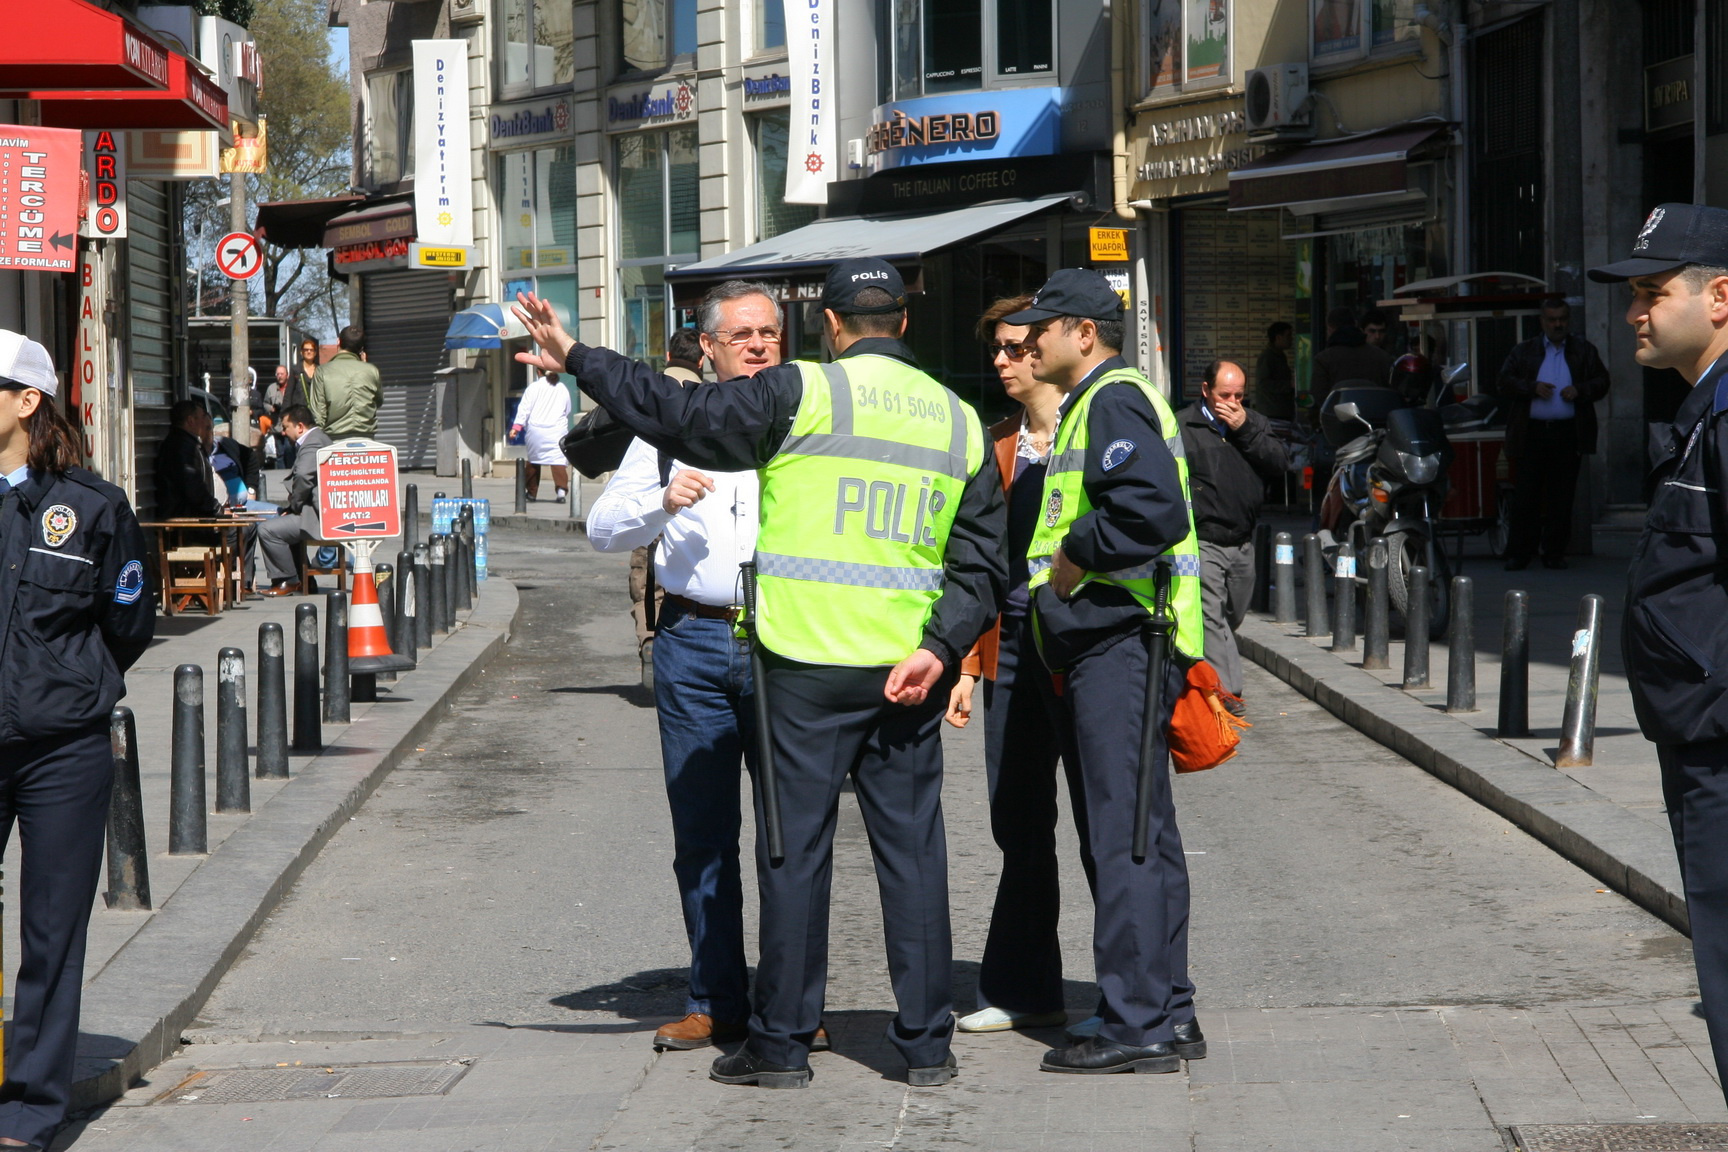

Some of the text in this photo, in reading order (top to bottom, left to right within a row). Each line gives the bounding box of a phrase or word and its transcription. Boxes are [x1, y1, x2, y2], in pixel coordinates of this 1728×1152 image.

[926, 70, 955, 79] CAPPUCCINO
[961, 66, 982, 74] ESPRESSO
[745, 73, 791, 97] DenizBan
[608, 89, 674, 122] DenizBank
[436, 59, 450, 206] DenizYatırım
[491, 108, 555, 139] DenizBank
[906, 110, 999, 146] NERO
[893, 183, 912, 198] THE
[914, 178, 950, 196] ITALIAN
[959, 173, 998, 191] COFFEE
[17, 152, 48, 253] TERCÜME
[385, 216, 409, 233] GOLD
[1097, 230, 1120, 239] ERKEK
[15, 257, 71, 268] FORMLARI
[851, 270, 889, 282] POLİS
[857, 384, 946, 423] 34 61 5049
[327, 478, 389, 486] FRANSA-HOLLANDA
[328, 488, 389, 509] VİZE FORMLARI
[343, 511, 371, 519] KAT:2
[833, 476, 947, 547] POLİS
